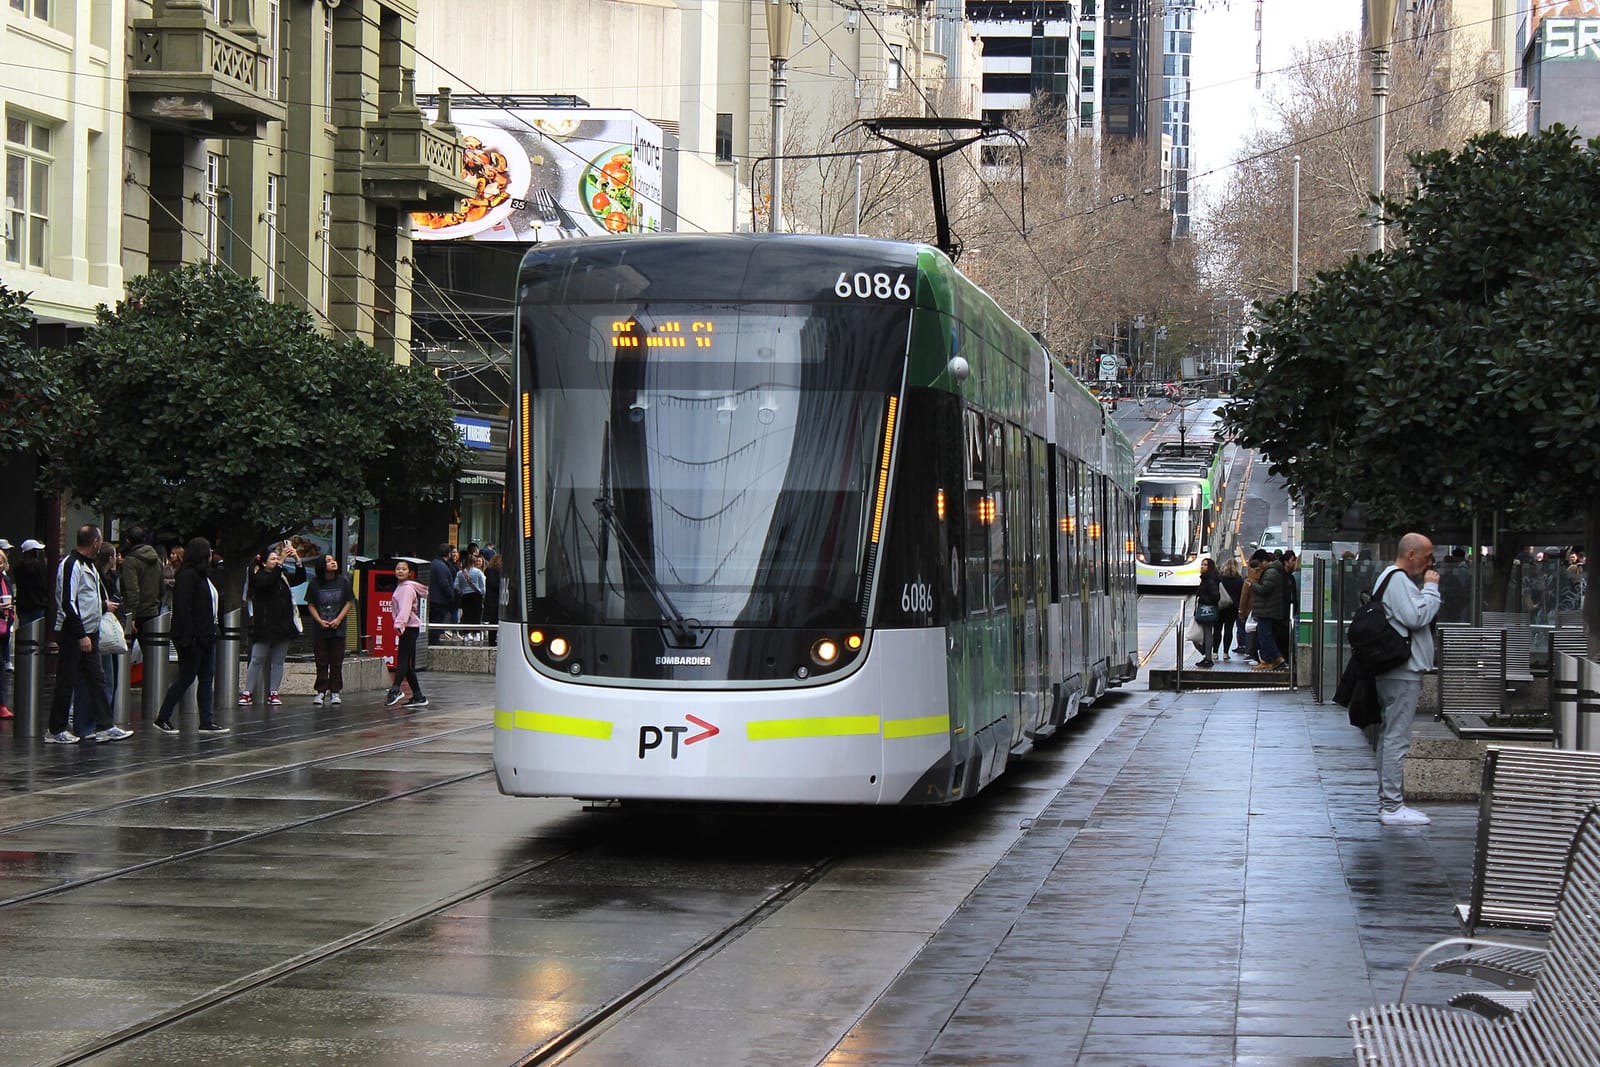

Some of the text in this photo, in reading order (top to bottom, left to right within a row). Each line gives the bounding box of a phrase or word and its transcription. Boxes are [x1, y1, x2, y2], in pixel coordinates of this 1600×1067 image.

[512, 200, 526, 210] 35
[834, 272, 911, 300] 6086
[460, 475, 488, 484] wealth
[901, 583, 933, 612] 6086
[655, 656, 711, 665] BOMBARDIER
